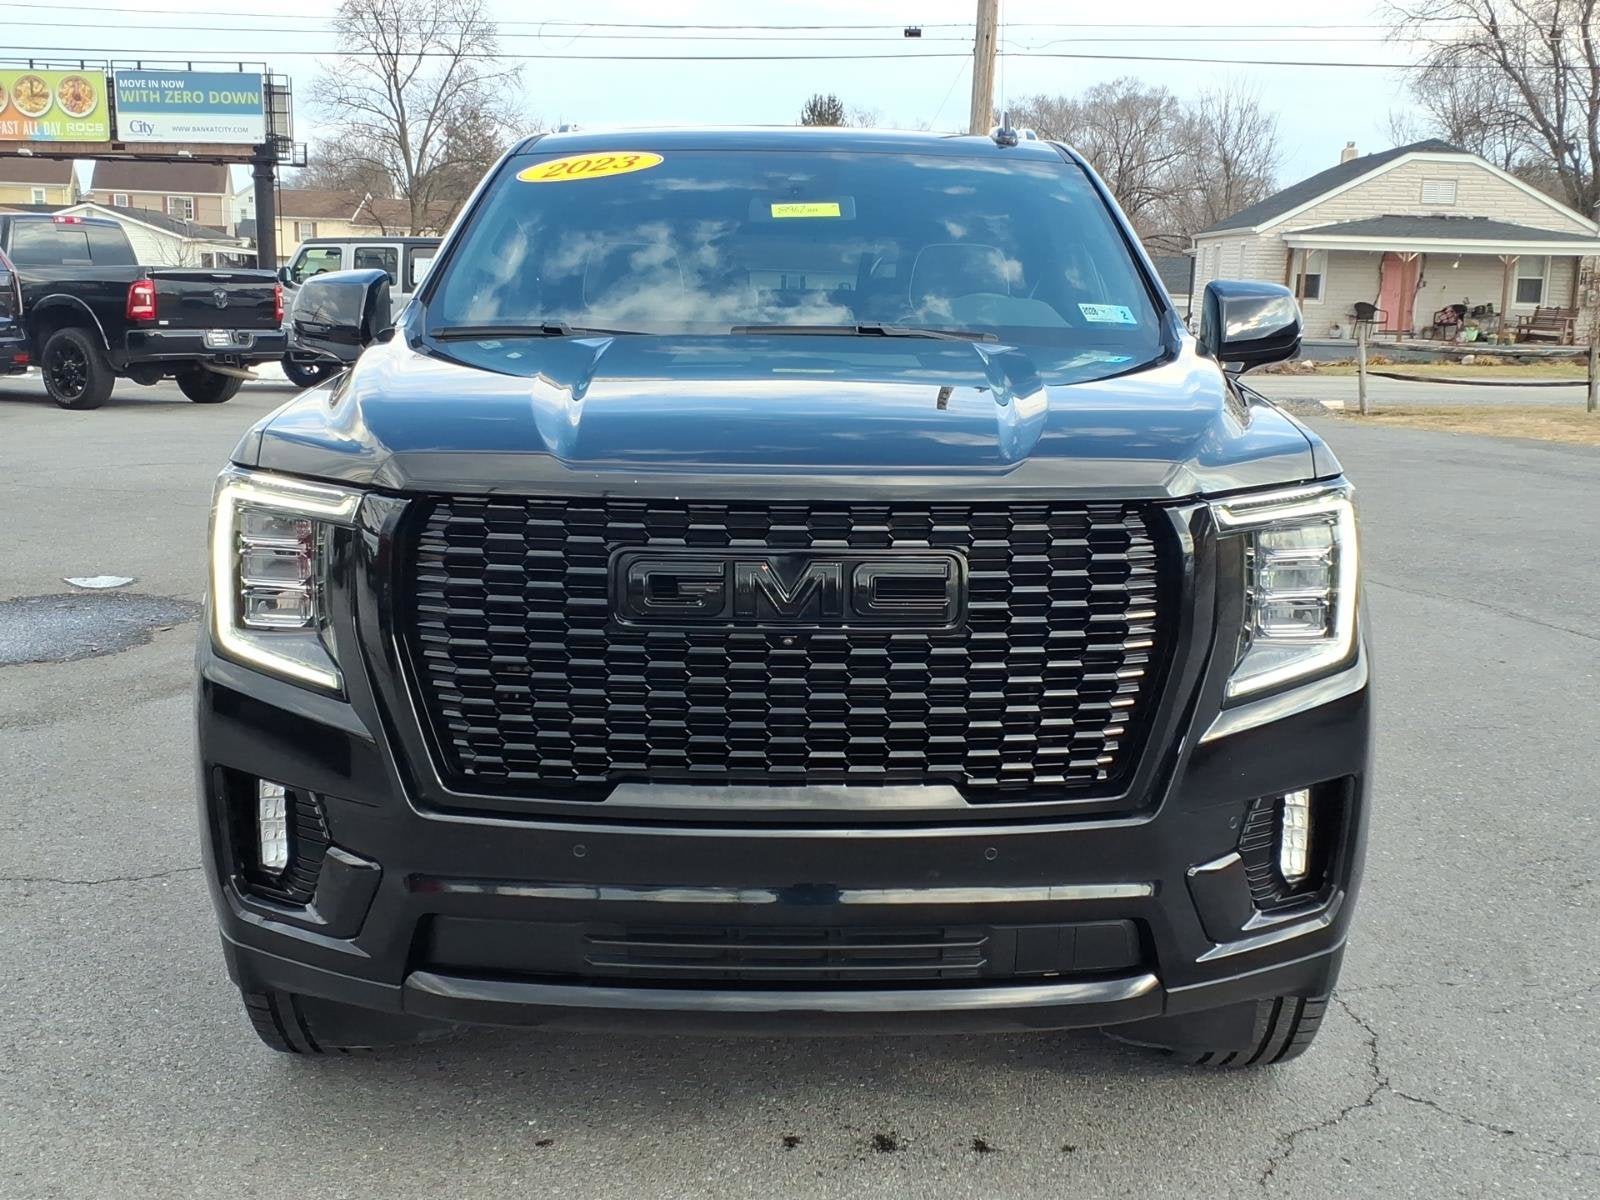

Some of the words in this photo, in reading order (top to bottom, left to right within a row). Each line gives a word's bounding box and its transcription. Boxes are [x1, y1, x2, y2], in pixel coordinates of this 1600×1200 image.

[119, 79, 146, 88] MOVE
[148, 79, 159, 88] IN
[161, 80, 185, 88] NOW
[120, 90, 161, 103] WITH
[164, 90, 204, 104] ZERO
[208, 91, 259, 105] DOWN
[23, 120, 41, 135] ALL
[129, 119, 155, 136] City
[171, 126, 249, 134] WWW.BANKATCITY.COM
[541, 155, 640, 178] 2023
[628, 559, 949, 617] GMC
